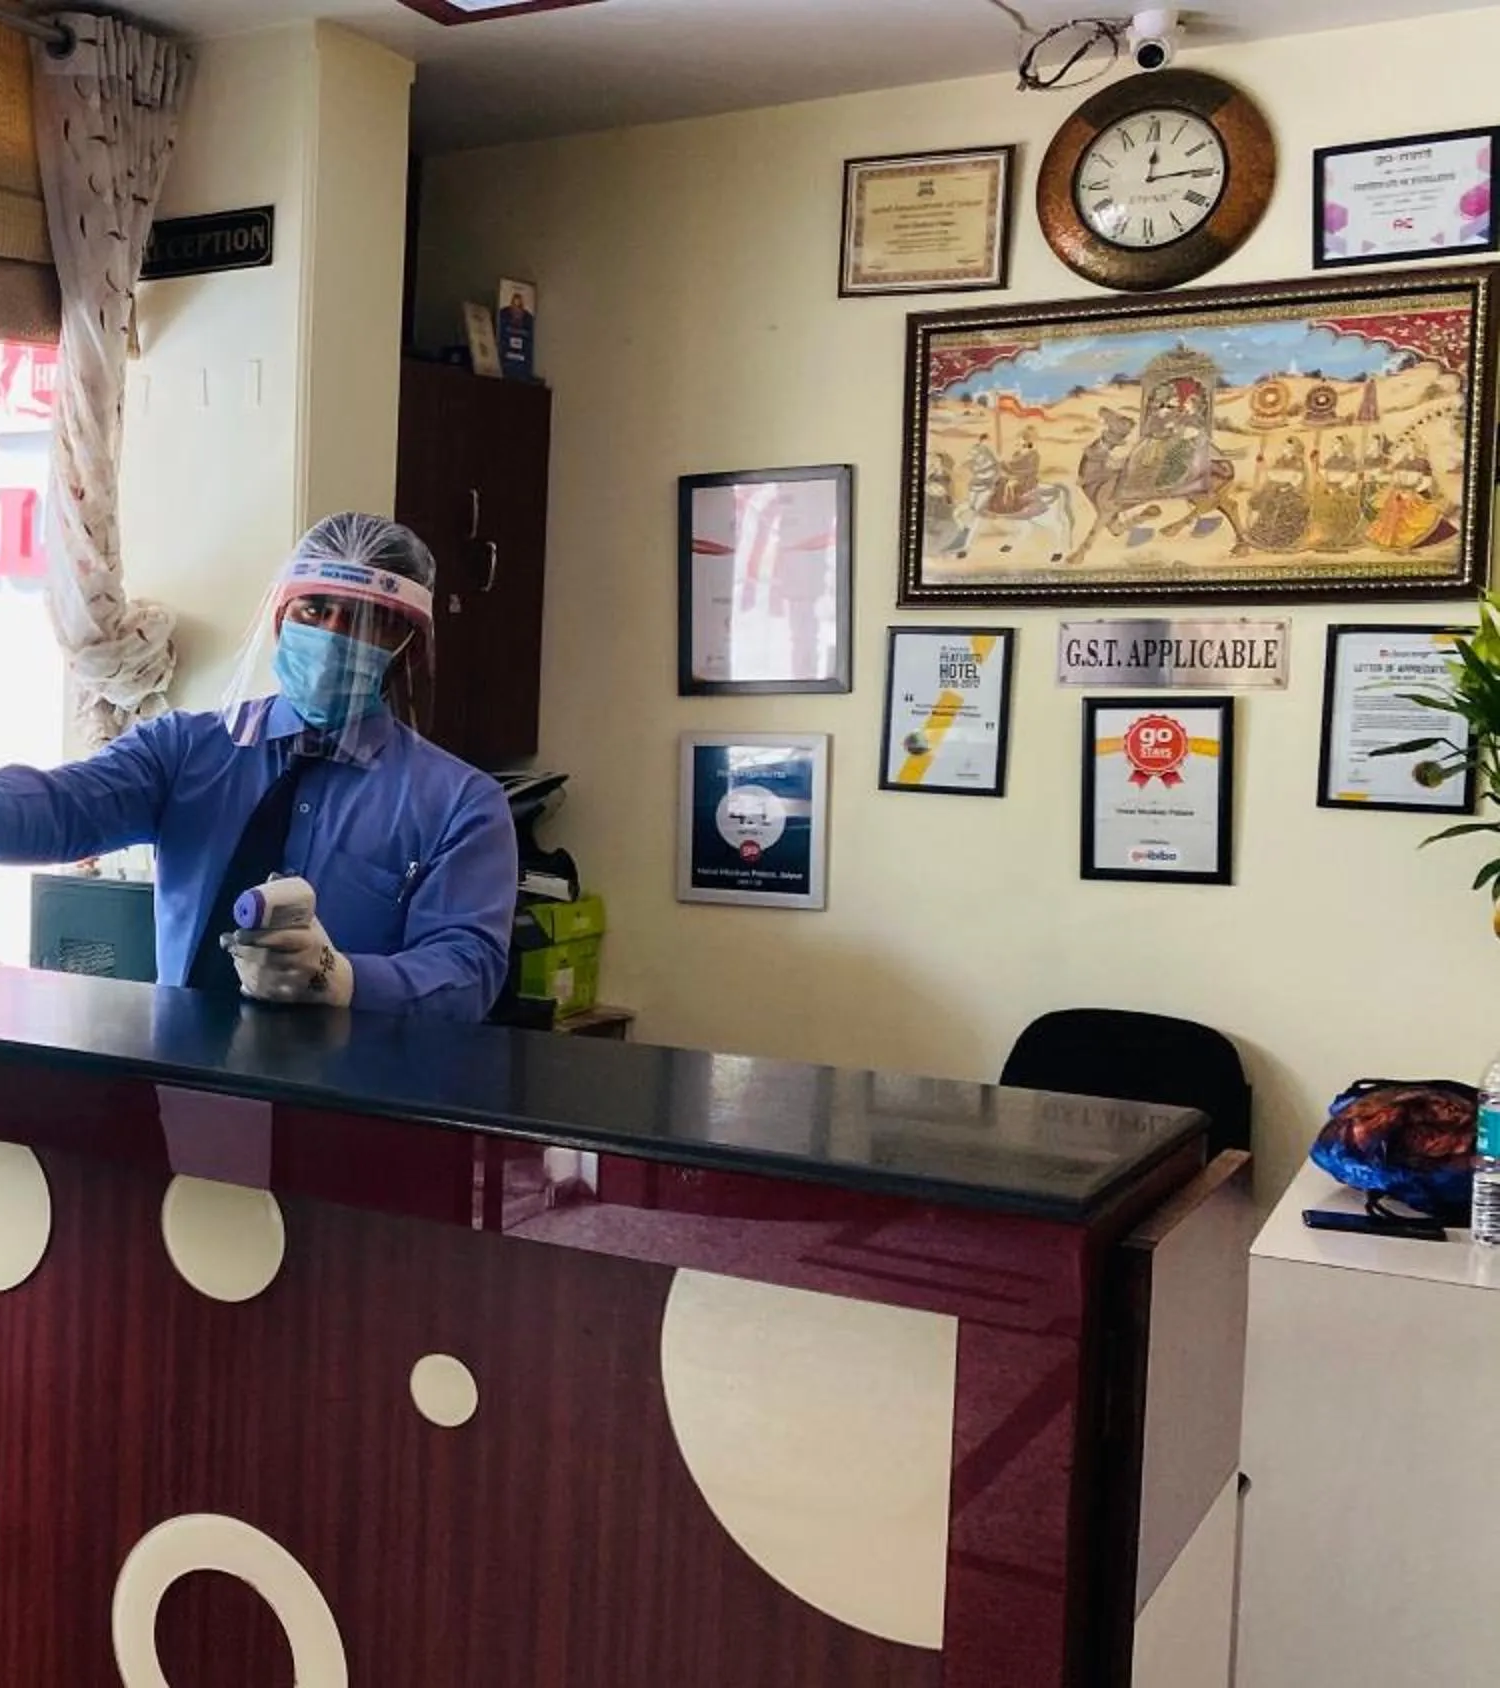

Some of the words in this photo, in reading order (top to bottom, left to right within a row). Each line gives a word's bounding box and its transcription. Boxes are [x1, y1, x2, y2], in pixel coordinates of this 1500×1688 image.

[1066, 639, 1121, 667] G.S.T.
[1127, 639, 1279, 669] APPLICABLE
[939, 663, 980, 679] HOTEL
[1139, 727, 1173, 747] go
